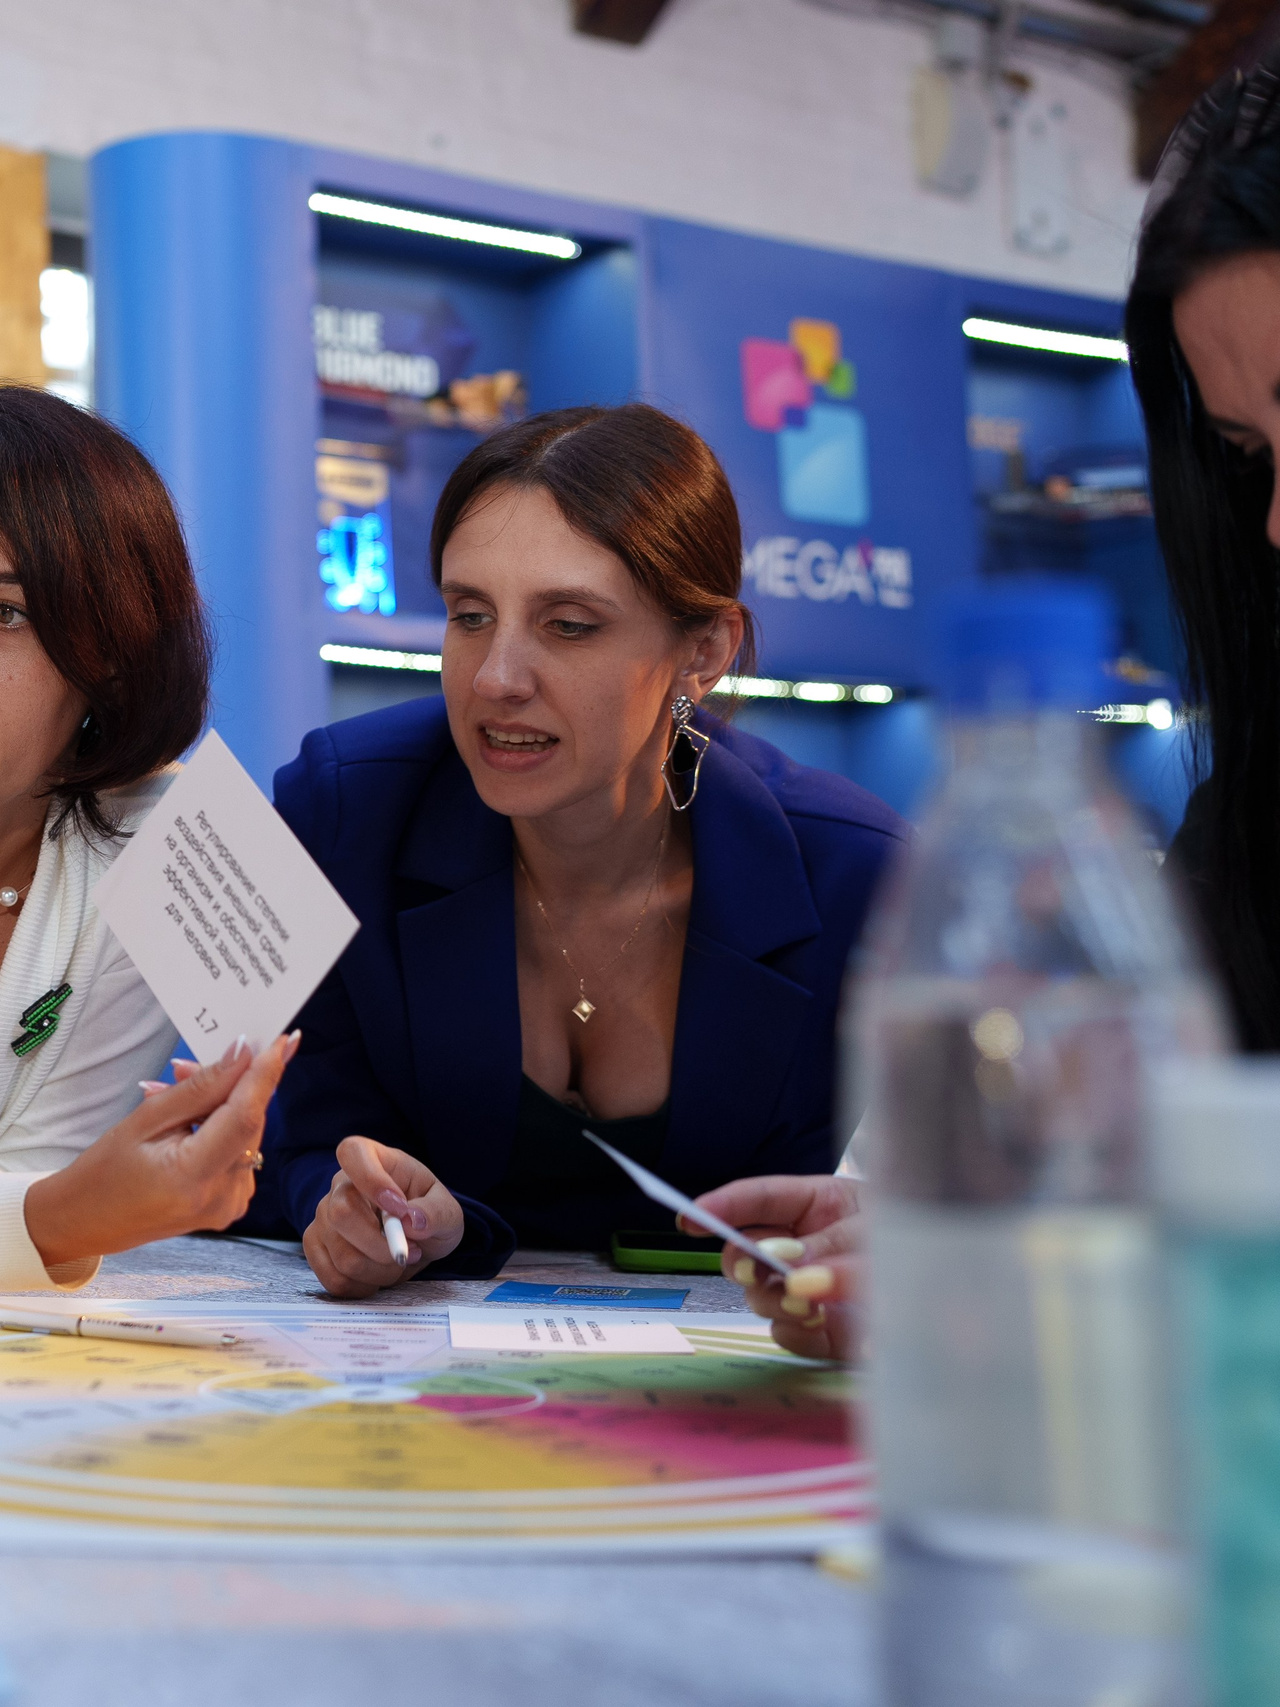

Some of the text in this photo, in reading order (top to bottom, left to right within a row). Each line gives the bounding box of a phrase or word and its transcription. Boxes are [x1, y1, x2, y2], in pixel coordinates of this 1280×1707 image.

[162, 863, 250, 988] эффективной защиты
[164, 833, 274, 988] на организм и обеспечение
[174, 815, 288, 974] воздействия внешней среды
[194, 810, 290, 942] Регулирование степени
[165, 902, 221, 980] для человека
[194, 1007, 219, 1034] 1.7
